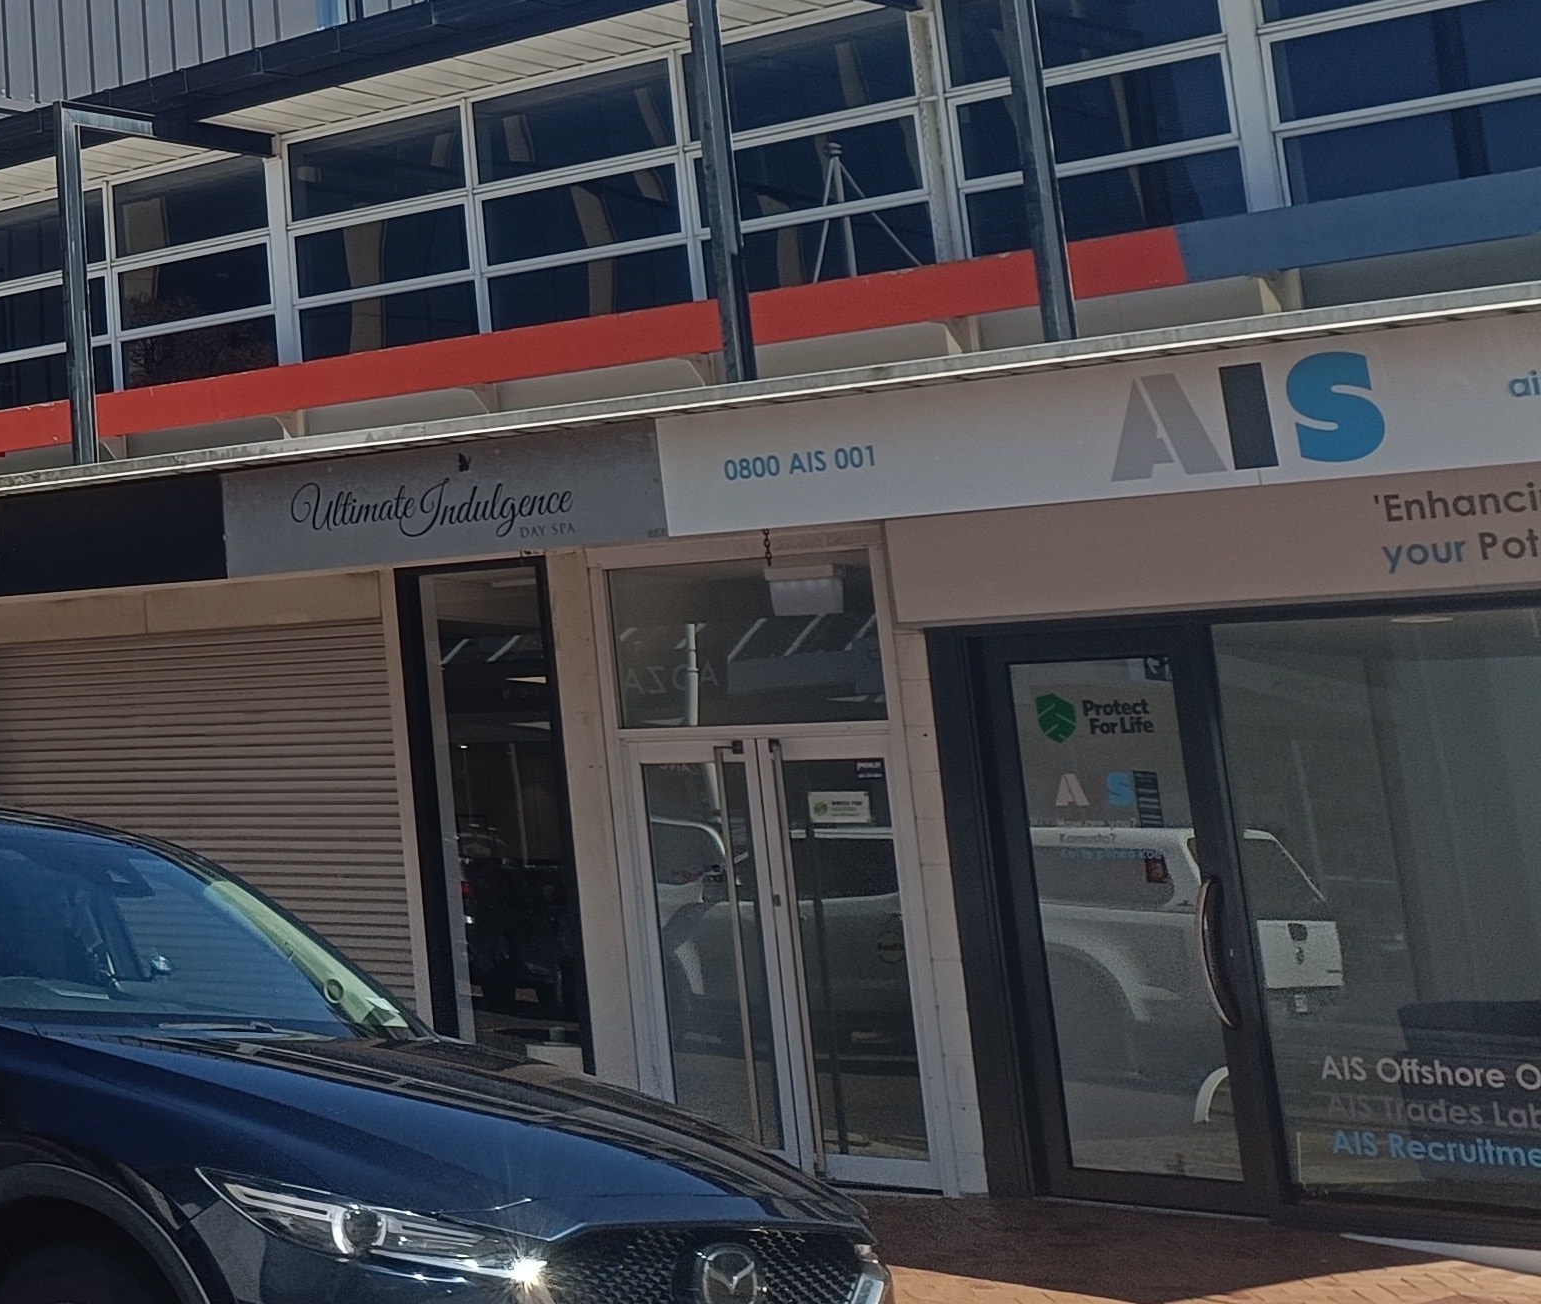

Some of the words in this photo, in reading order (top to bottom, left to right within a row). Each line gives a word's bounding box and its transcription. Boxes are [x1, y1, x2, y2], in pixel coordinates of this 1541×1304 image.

[1111, 350, 1386, 483] AIS
[724, 455, 781, 481] 0800
[789, 450, 827, 475] AIS
[834, 445, 876, 470] 001
[290, 482, 415, 532] Ultimate
[399, 477, 574, 538] Indulgence
[1373, 481, 1541, 523] 'Enhanci
[520, 526, 546, 539] DAY
[552, 522, 576, 536] SPA
[1381, 540, 1466, 574] your
[1082, 699, 1150, 717] Protect
[1089, 718, 1118, 735] For
[1120, 716, 1155, 734] Life
[1321, 1055, 1367, 1082] AIS
[1376, 1056, 1507, 1089] Offshore
[1327, 1095, 1374, 1120] AIS
[1379, 1096, 1483, 1126] Trades
[1332, 1129, 1379, 1158] AIS
